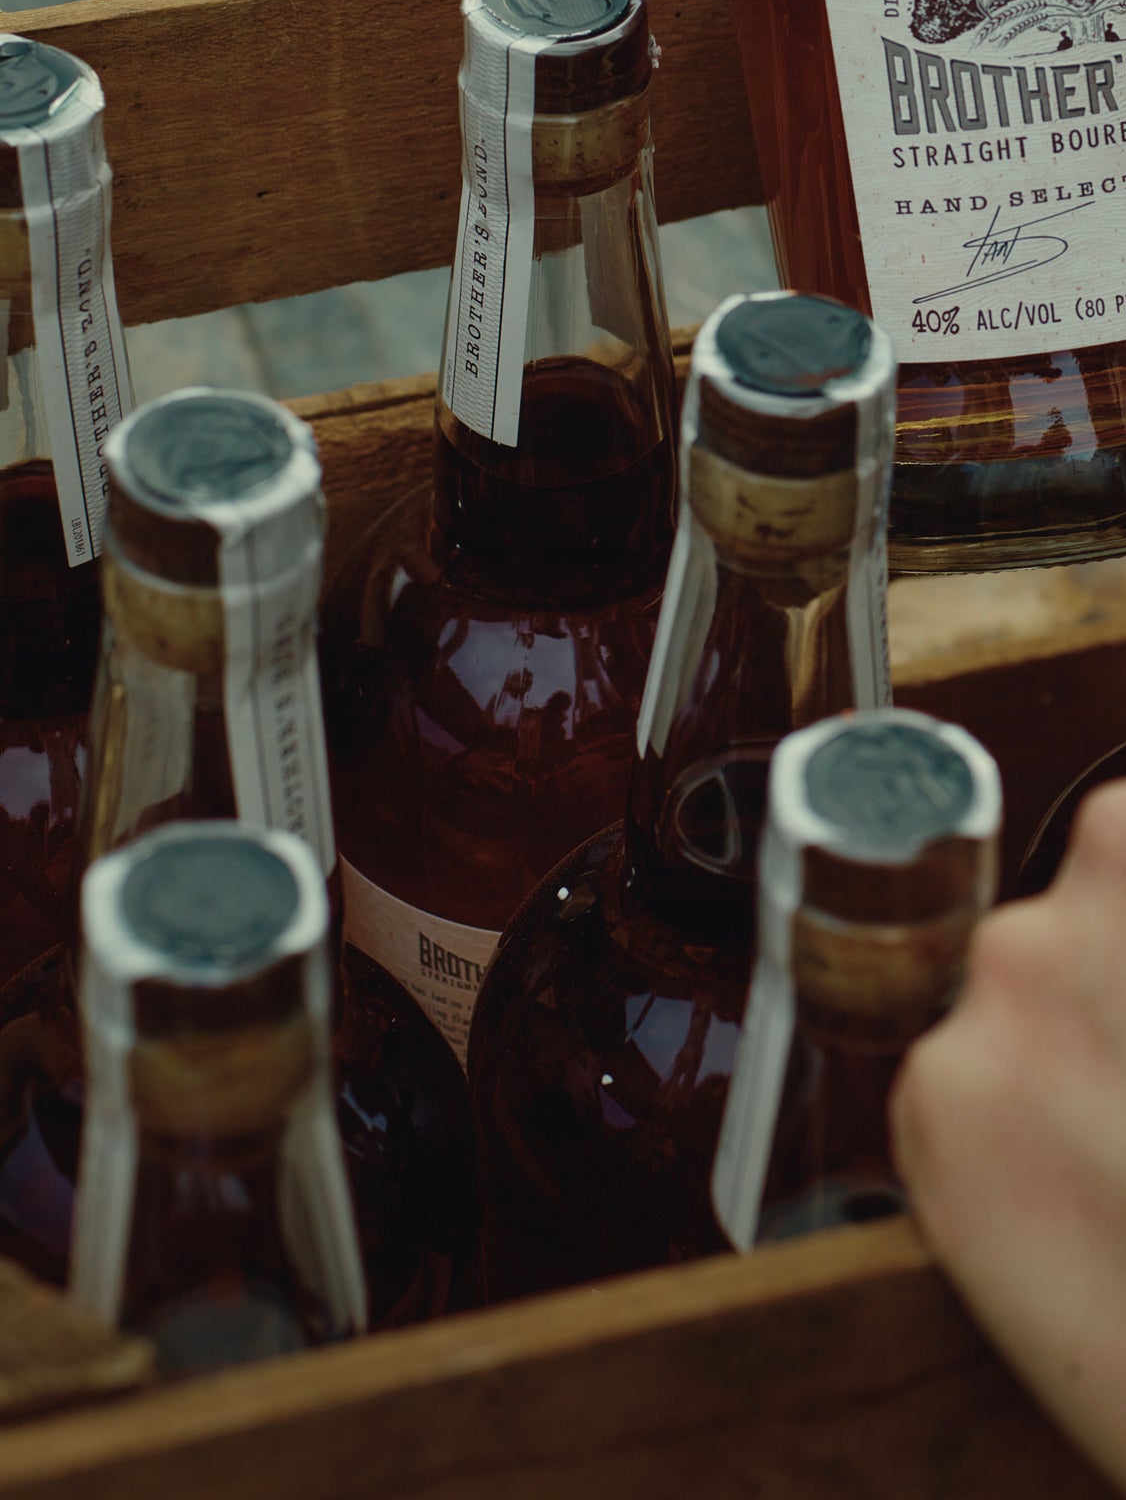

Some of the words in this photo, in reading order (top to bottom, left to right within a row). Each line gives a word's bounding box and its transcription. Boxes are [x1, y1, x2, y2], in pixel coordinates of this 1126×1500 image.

[892, 136, 1029, 169] STRAIGHT
[895, 194, 989, 216] HAND
[465, 223, 490, 378] BROTHER'S
[911, 305, 960, 335] 40%
[976, 301, 1062, 332] ALC/VOL
[1074, 296, 1106, 321] (80
